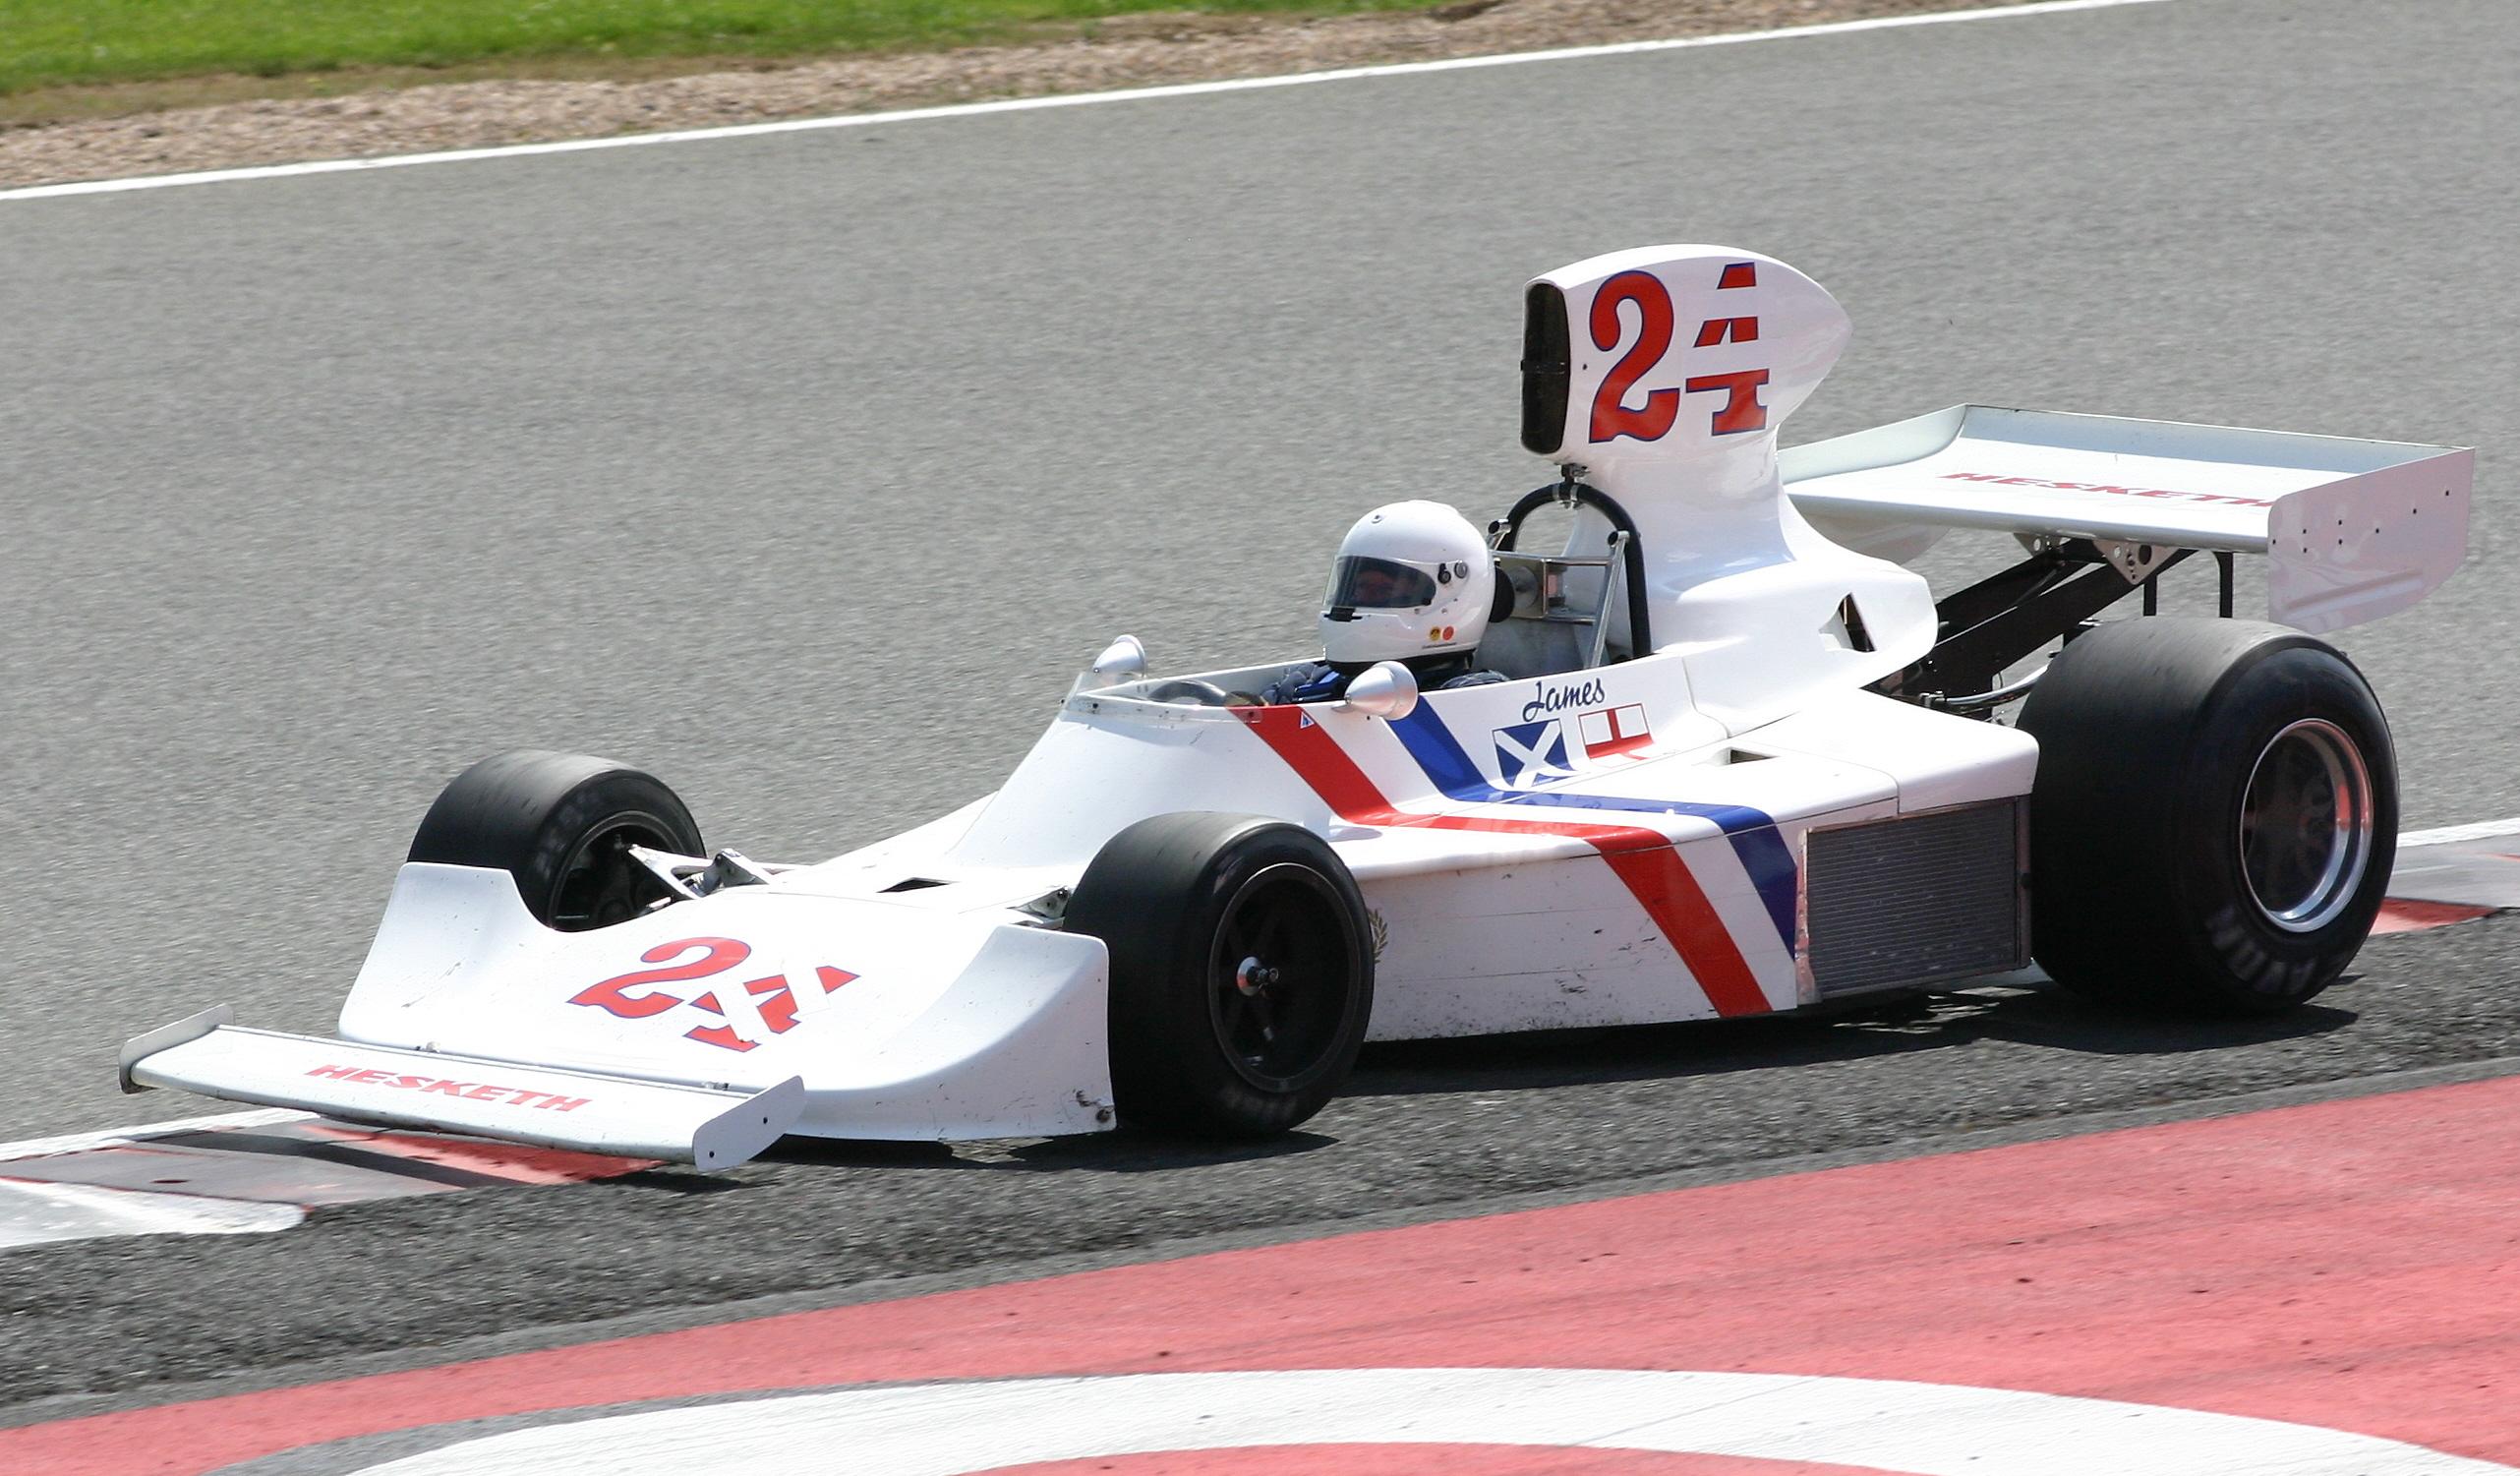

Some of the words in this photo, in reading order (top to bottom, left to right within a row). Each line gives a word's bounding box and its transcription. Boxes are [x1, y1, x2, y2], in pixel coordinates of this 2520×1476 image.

[1936, 472, 2274, 507] HESKETH
[1522, 677, 1606, 723] James
[304, 1064, 593, 1112] HESKETH
